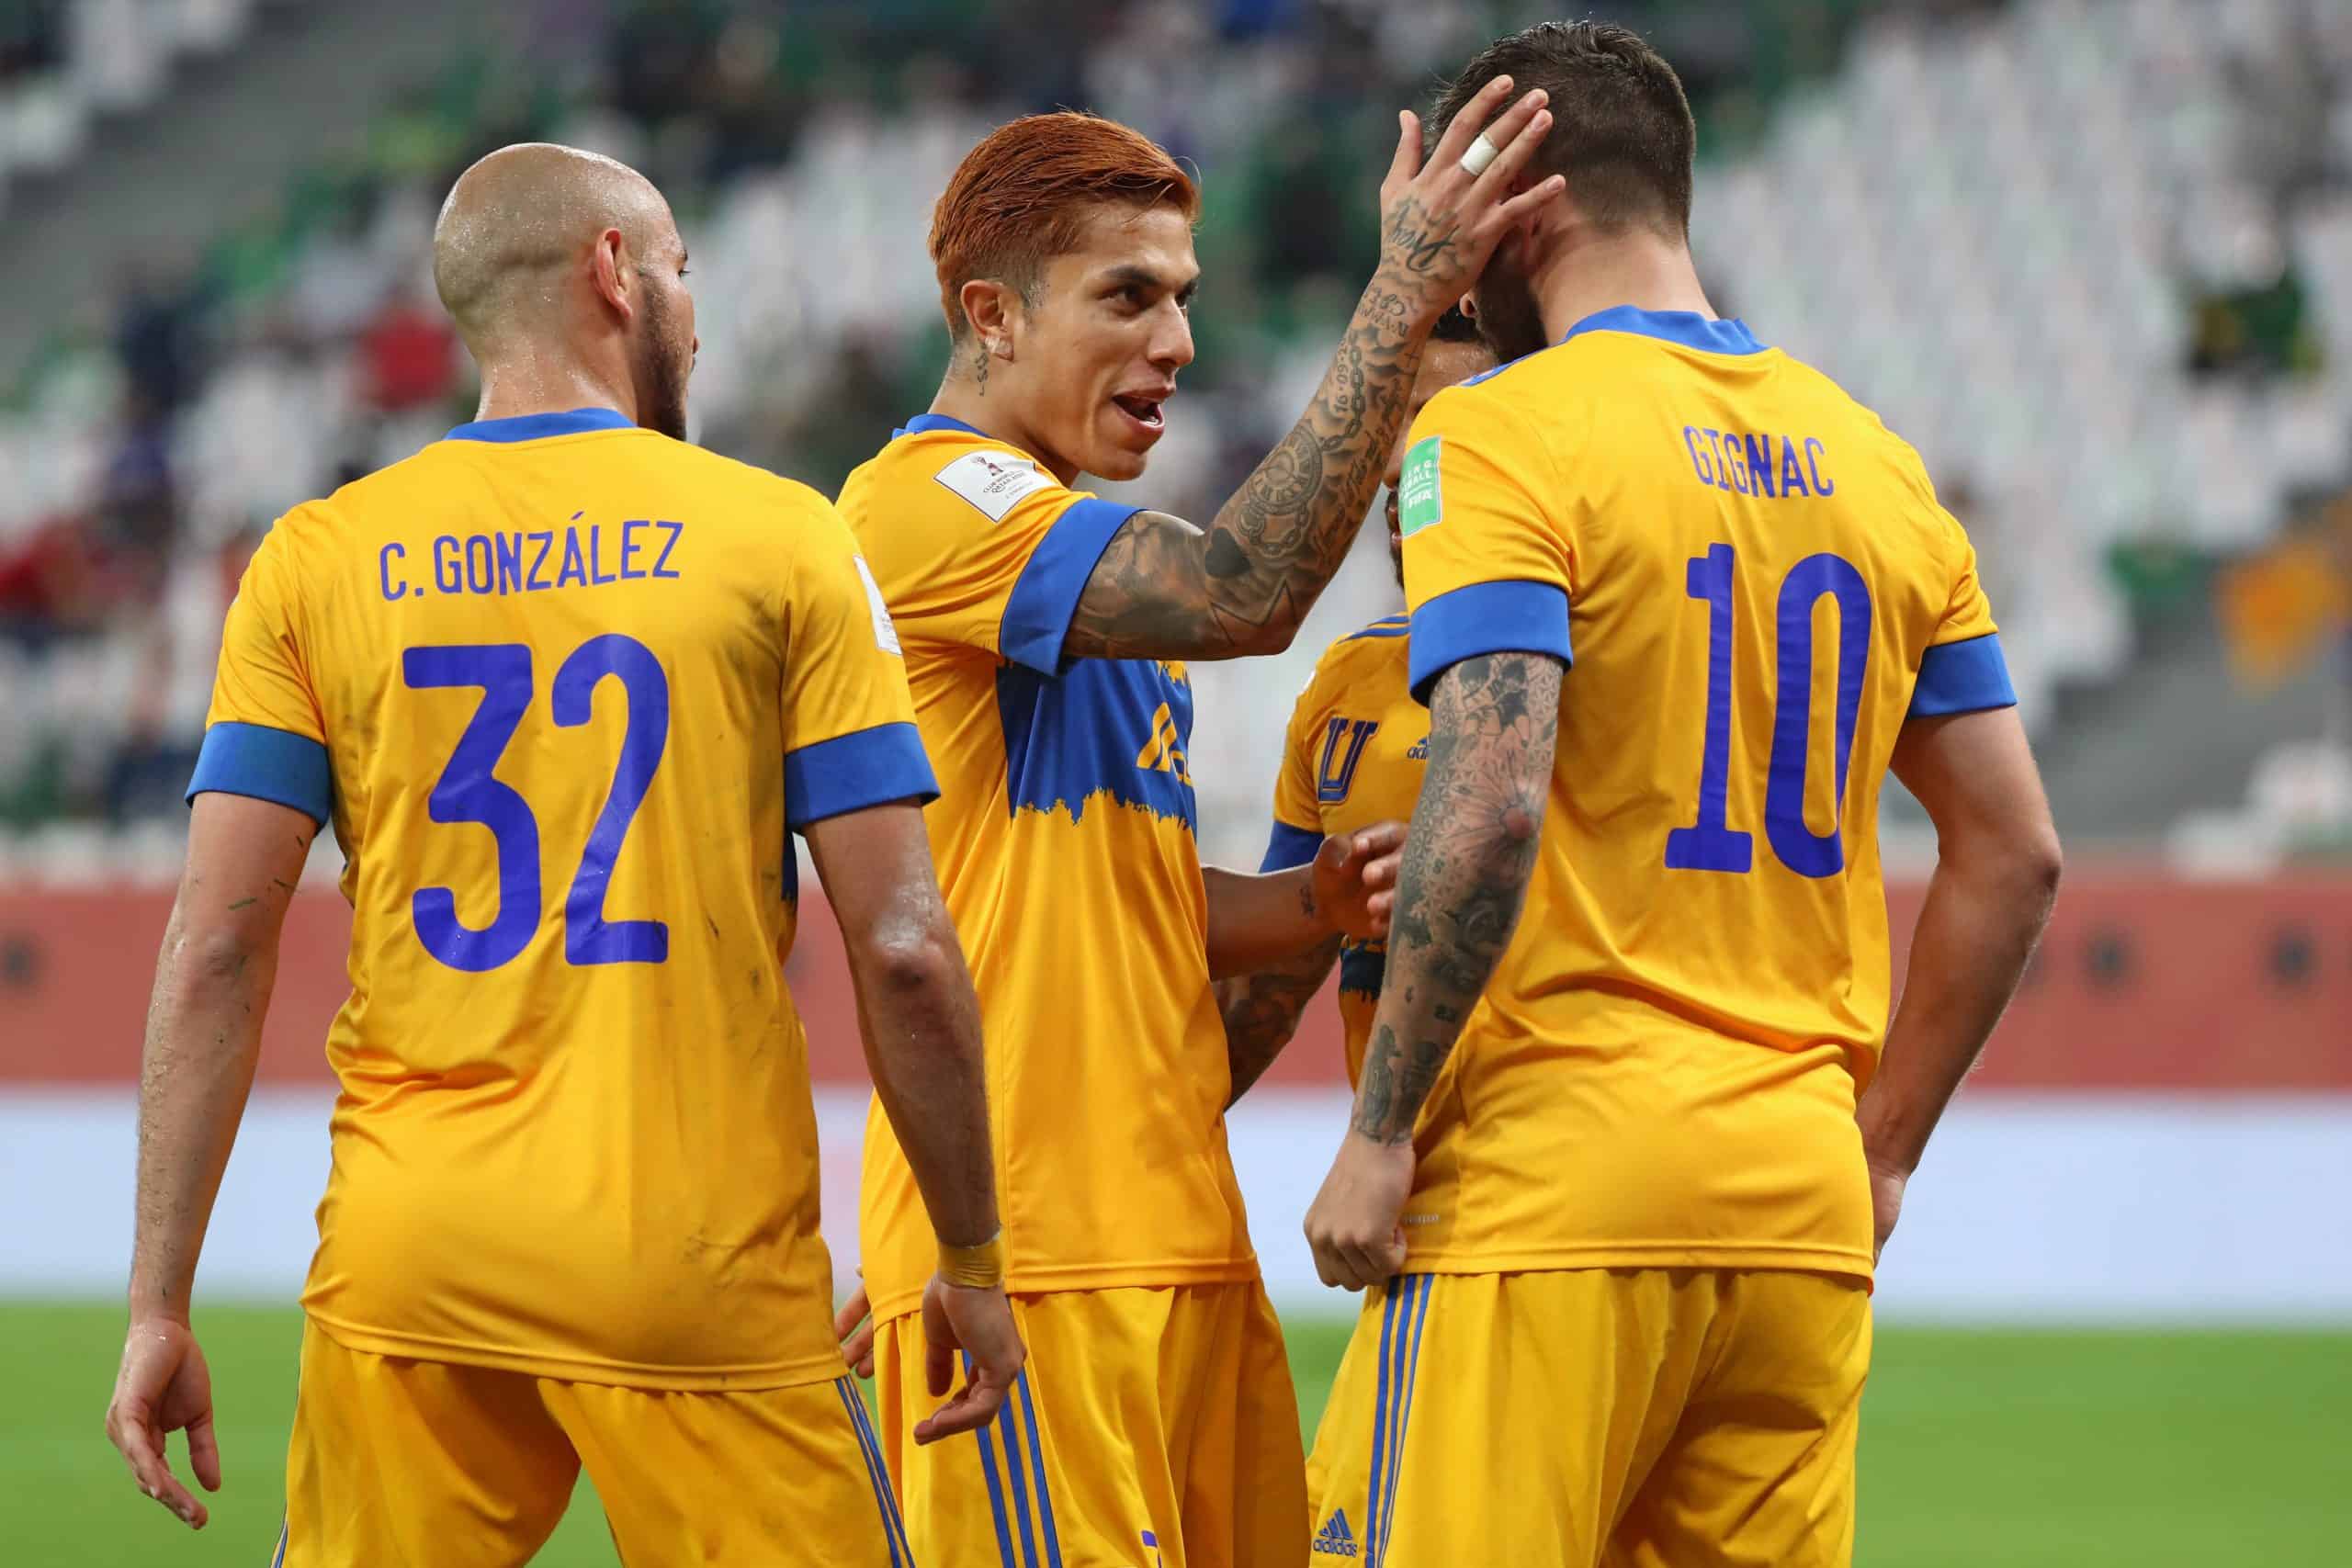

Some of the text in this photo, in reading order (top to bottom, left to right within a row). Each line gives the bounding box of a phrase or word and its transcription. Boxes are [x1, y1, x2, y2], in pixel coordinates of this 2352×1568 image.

[1683, 425, 1835, 499] GIGNAC
[1664, 542, 1872, 879] 10
[402, 633, 670, 973] 32
[1317, 716, 1380, 803] U
[1313, 1539, 1358, 1559] adidas
